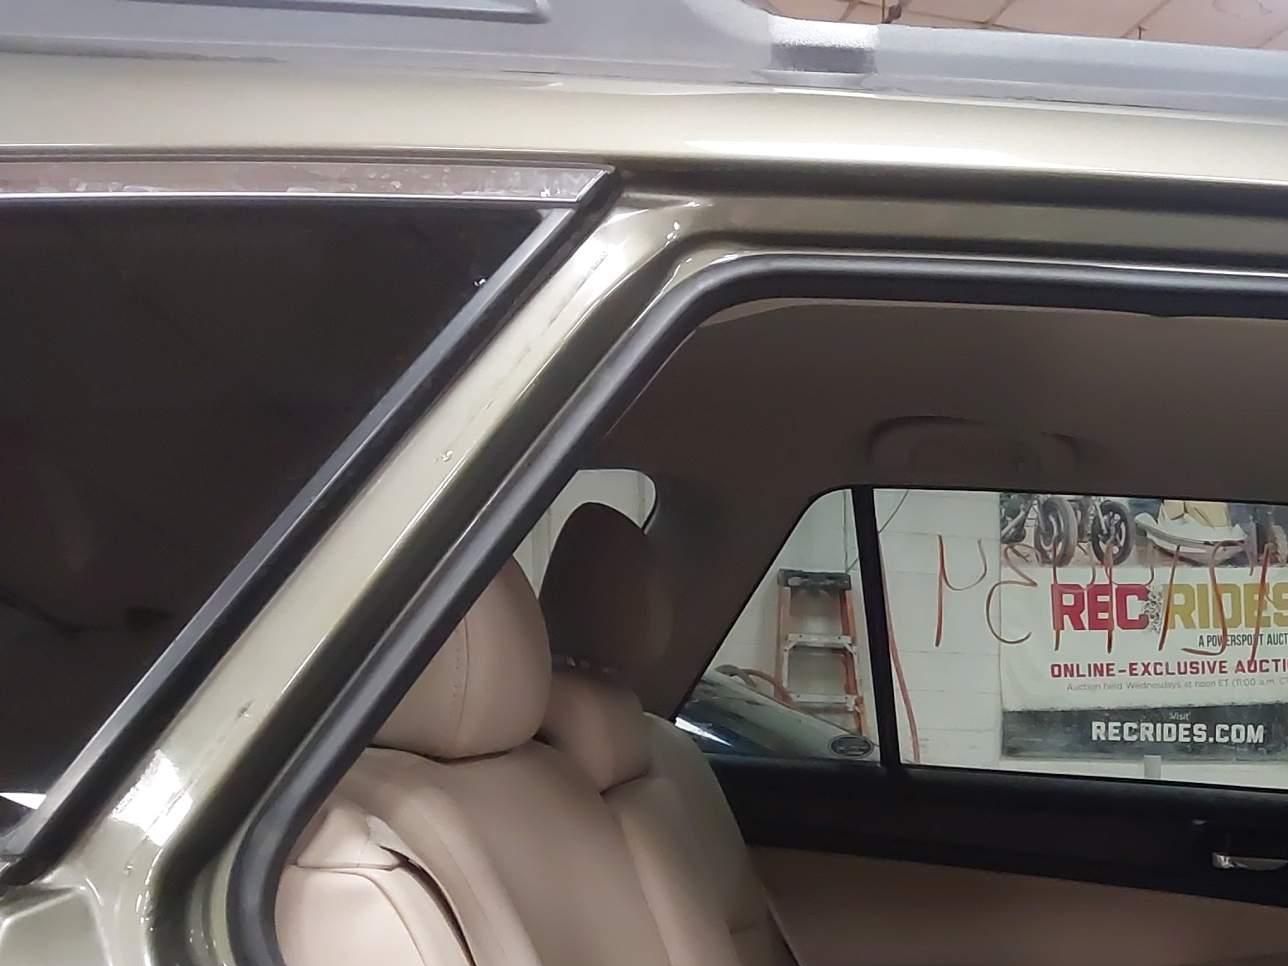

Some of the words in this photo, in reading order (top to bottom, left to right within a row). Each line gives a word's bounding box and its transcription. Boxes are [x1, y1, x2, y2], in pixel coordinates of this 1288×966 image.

[1051, 583, 1149, 630] REC
[1198, 635, 1205, 648] A
[1050, 660, 1228, 678] ONLINE-EXCLUSIVE
[1195, 679, 1216, 688] noon
[1091, 721, 1264, 744] RECRIDES.COM
